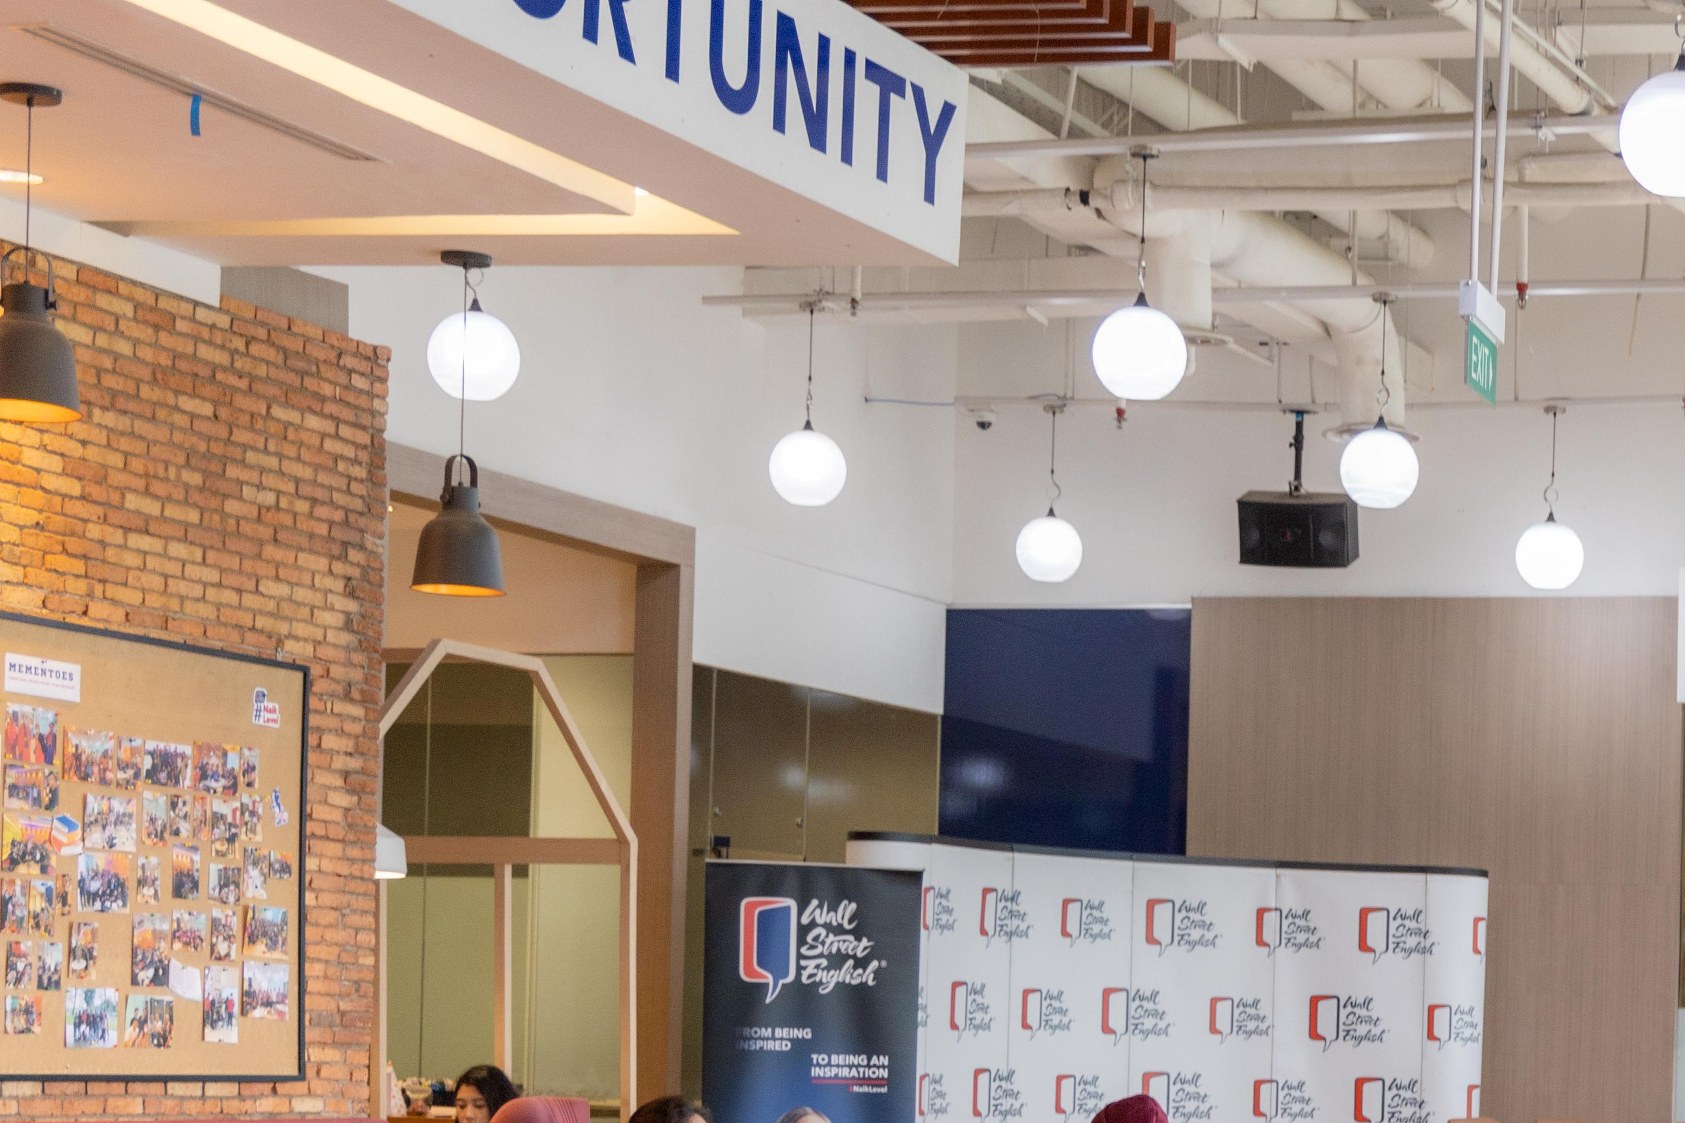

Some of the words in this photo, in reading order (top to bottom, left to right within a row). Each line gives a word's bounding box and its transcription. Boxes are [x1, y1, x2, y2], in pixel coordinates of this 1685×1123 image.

[510, 0, 957, 208] TUNITY
[1471, 335, 1489, 390] EXIT
[9, 662, 74, 682] MEMENTOES
[800, 899, 858, 929] Wall
[800, 927, 875, 958] Street
[736, 1027, 771, 1038] FROM
[775, 1028, 812, 1039] BEING
[811, 1054, 828, 1065] TO
[831, 1054, 867, 1065] BEING
[870, 1055, 889, 1066] AN
[811, 1066, 888, 1078] INSPIRATION
